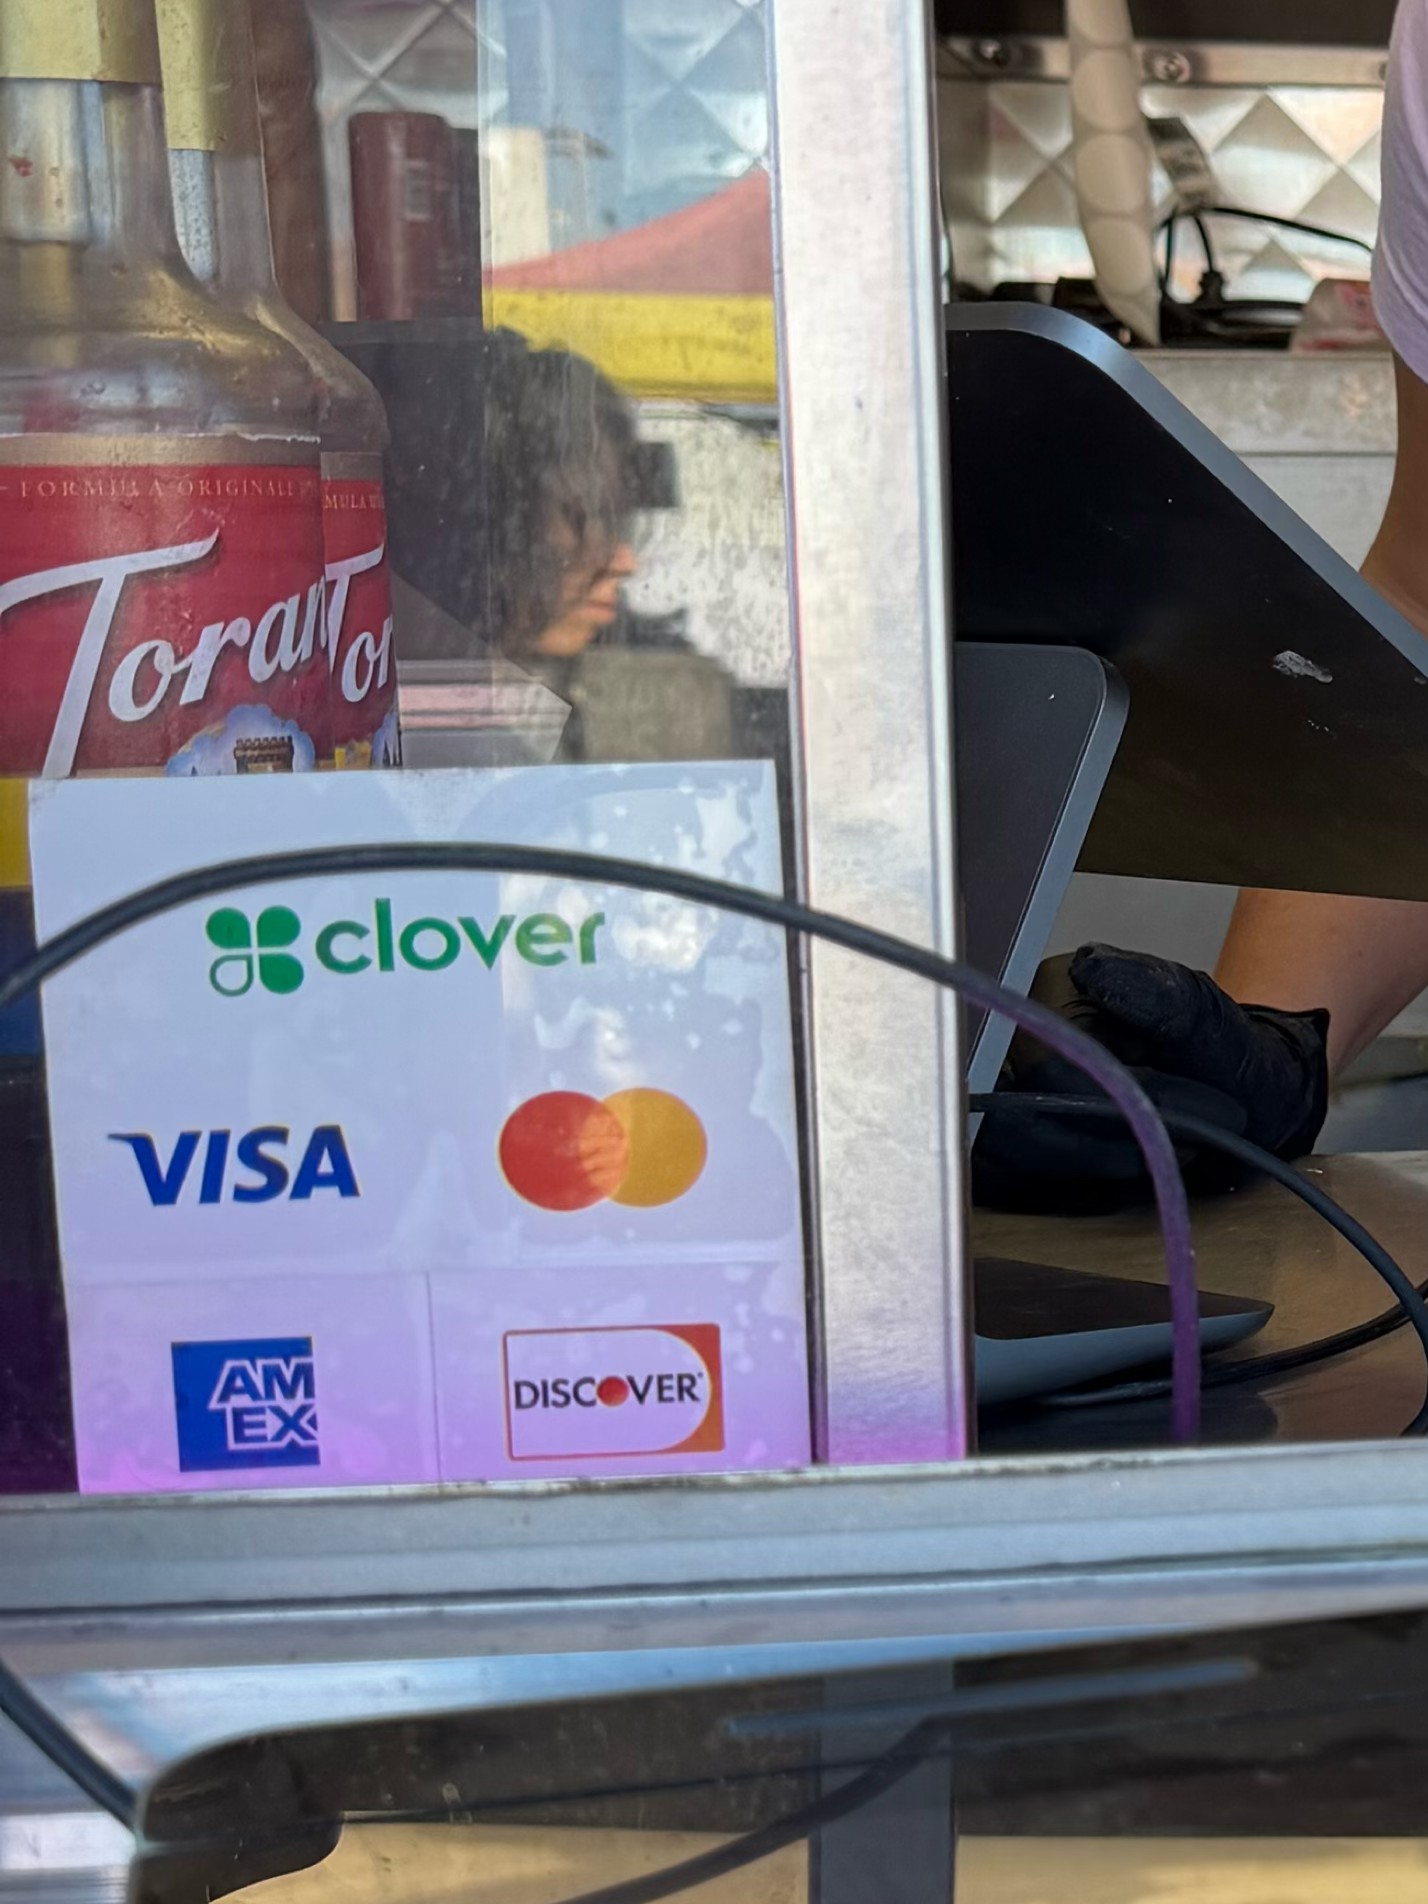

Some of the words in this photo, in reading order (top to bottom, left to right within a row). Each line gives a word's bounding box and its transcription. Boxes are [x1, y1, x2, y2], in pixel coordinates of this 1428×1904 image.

[315, 897, 605, 974] clover
[108, 1125, 361, 1206] VISA
[514, 1371, 701, 1410] DISCOVER
